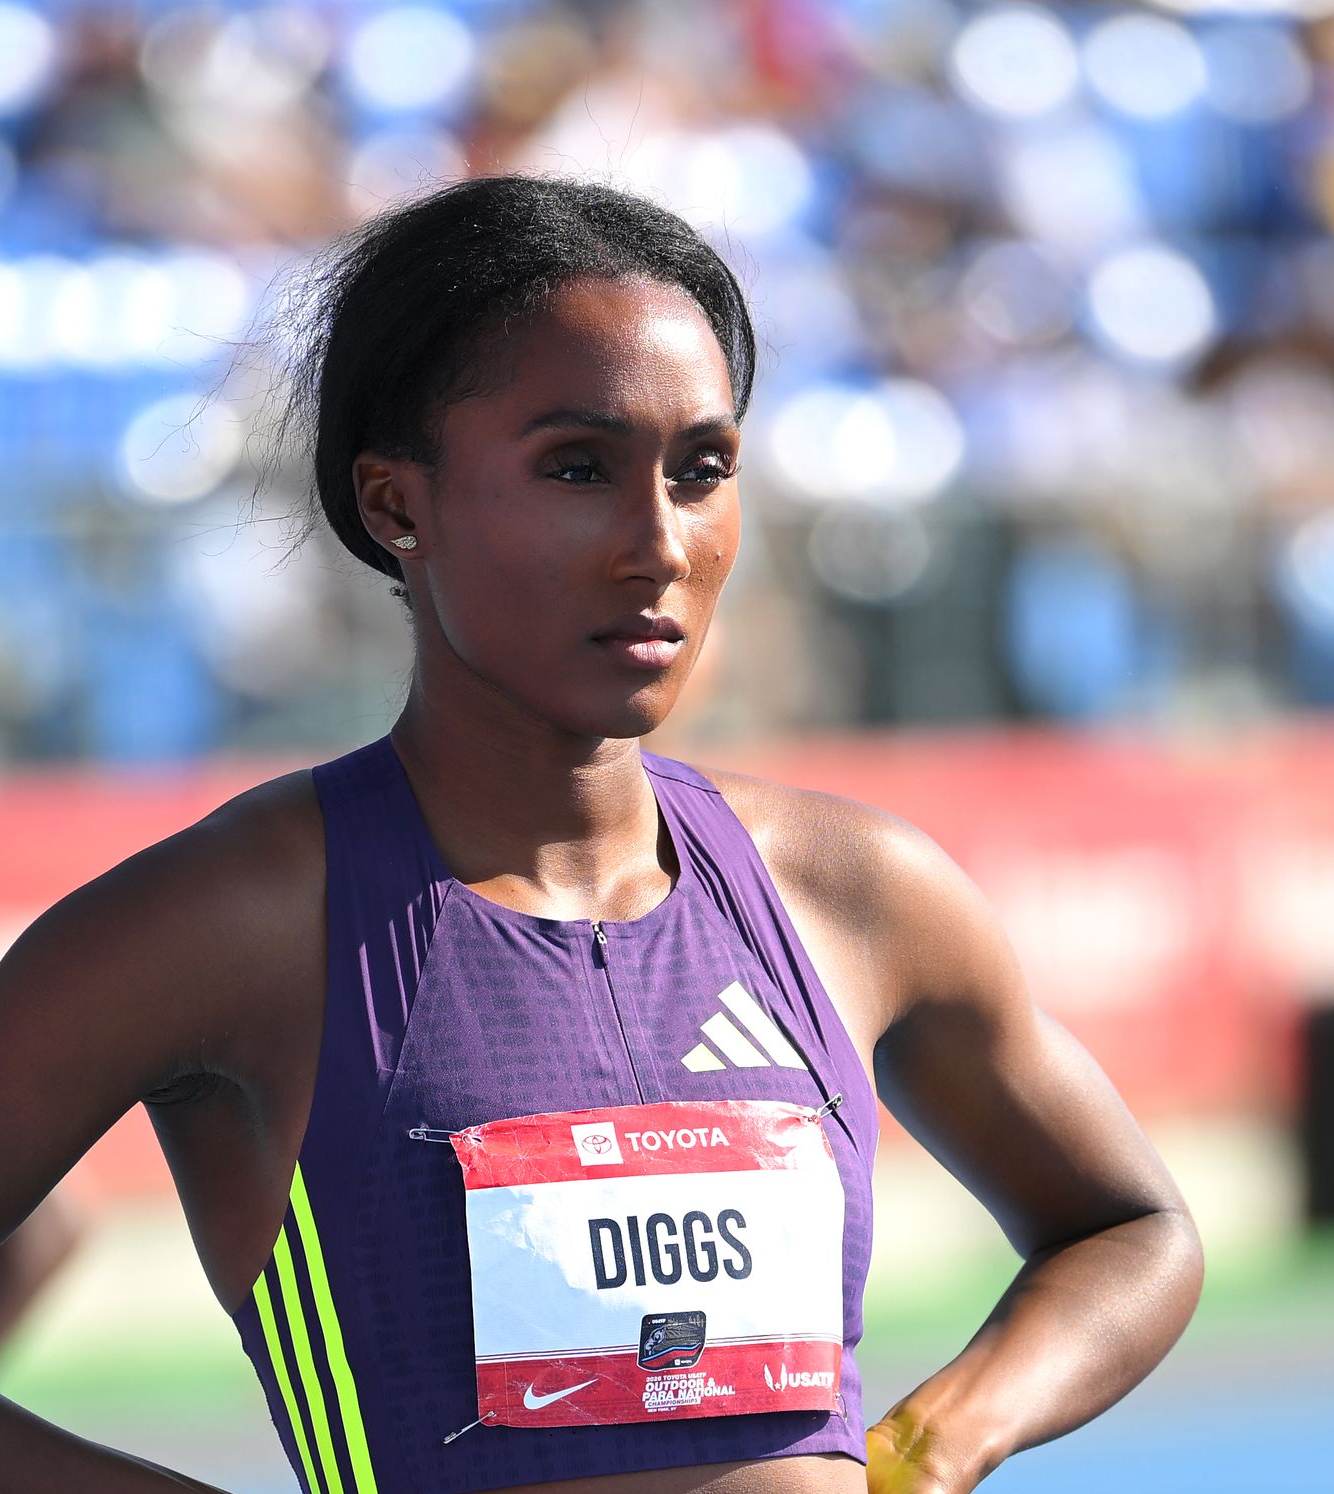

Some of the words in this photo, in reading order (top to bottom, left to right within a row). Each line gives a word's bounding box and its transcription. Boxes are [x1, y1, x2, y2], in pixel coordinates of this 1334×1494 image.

[624, 1127, 730, 1152] TOYOTA
[588, 1209, 753, 1290] DIGGS
[645, 1378, 704, 1392] OUTDOOR
[707, 1377, 716, 1387] &
[663, 1373, 687, 1381] TOYOTA
[788, 1371, 835, 1388] USATF
[642, 1389, 674, 1402] PARA
[677, 1385, 736, 1400] NATIONAL
[647, 1398, 698, 1407] CHAMPIONSHIPS
